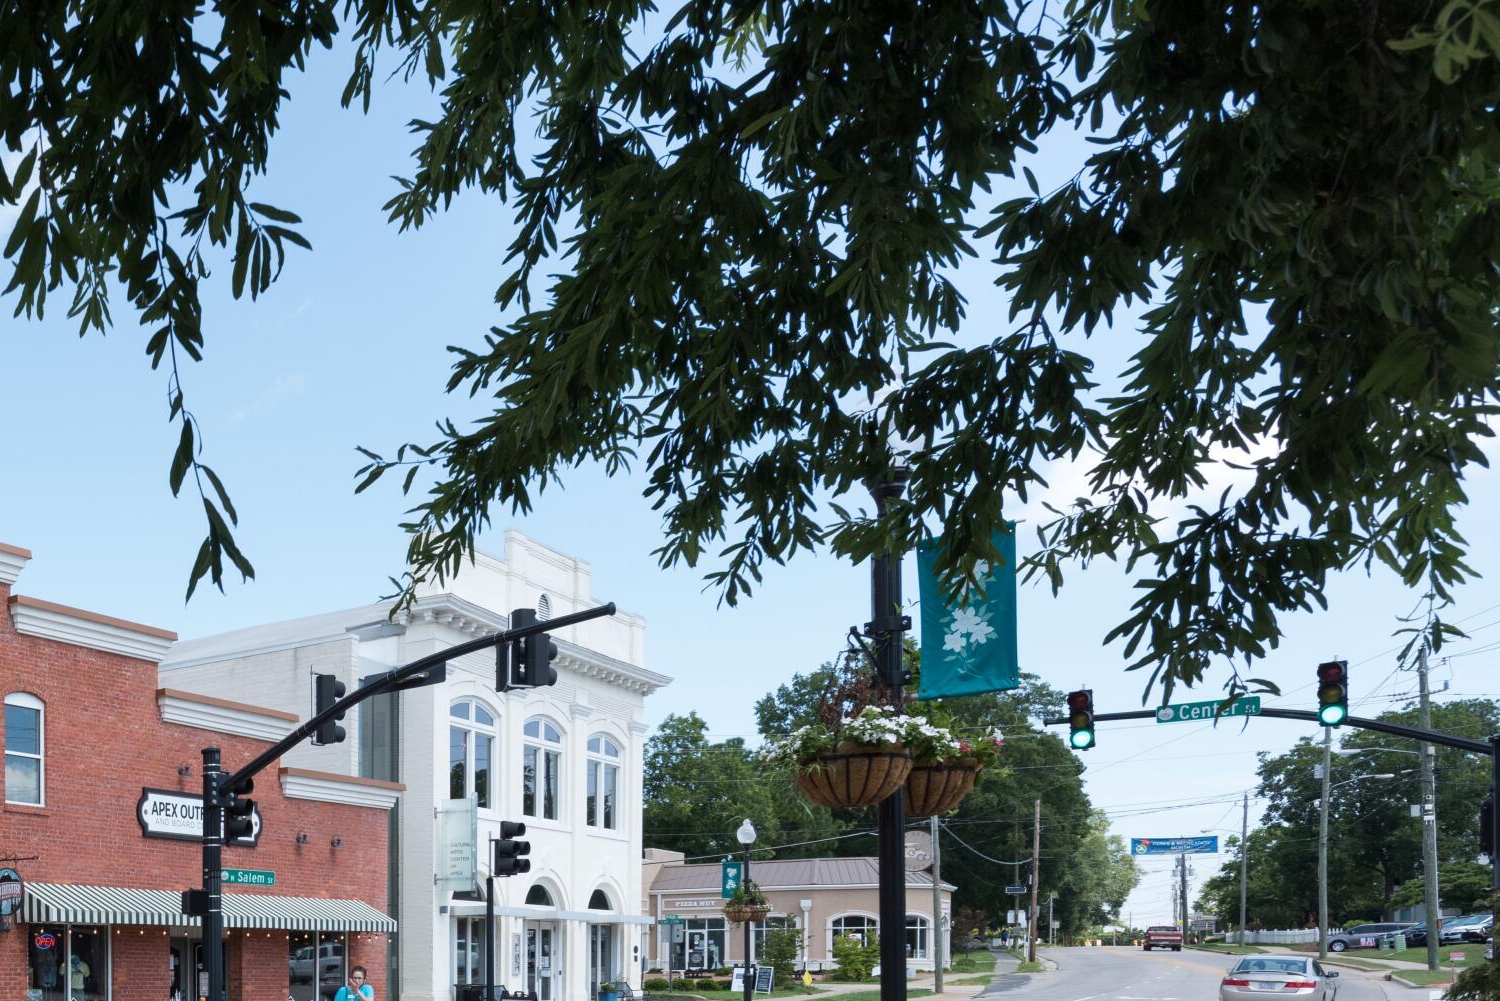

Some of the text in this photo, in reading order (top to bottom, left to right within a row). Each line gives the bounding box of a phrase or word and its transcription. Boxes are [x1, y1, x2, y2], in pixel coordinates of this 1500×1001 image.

[1245, 704, 1256, 713] St
[152, 801, 178, 818] APEX
[172, 819, 195, 829] BOARD
[237, 872, 265, 883] Salem
[35, 937, 56, 946] OPEN
